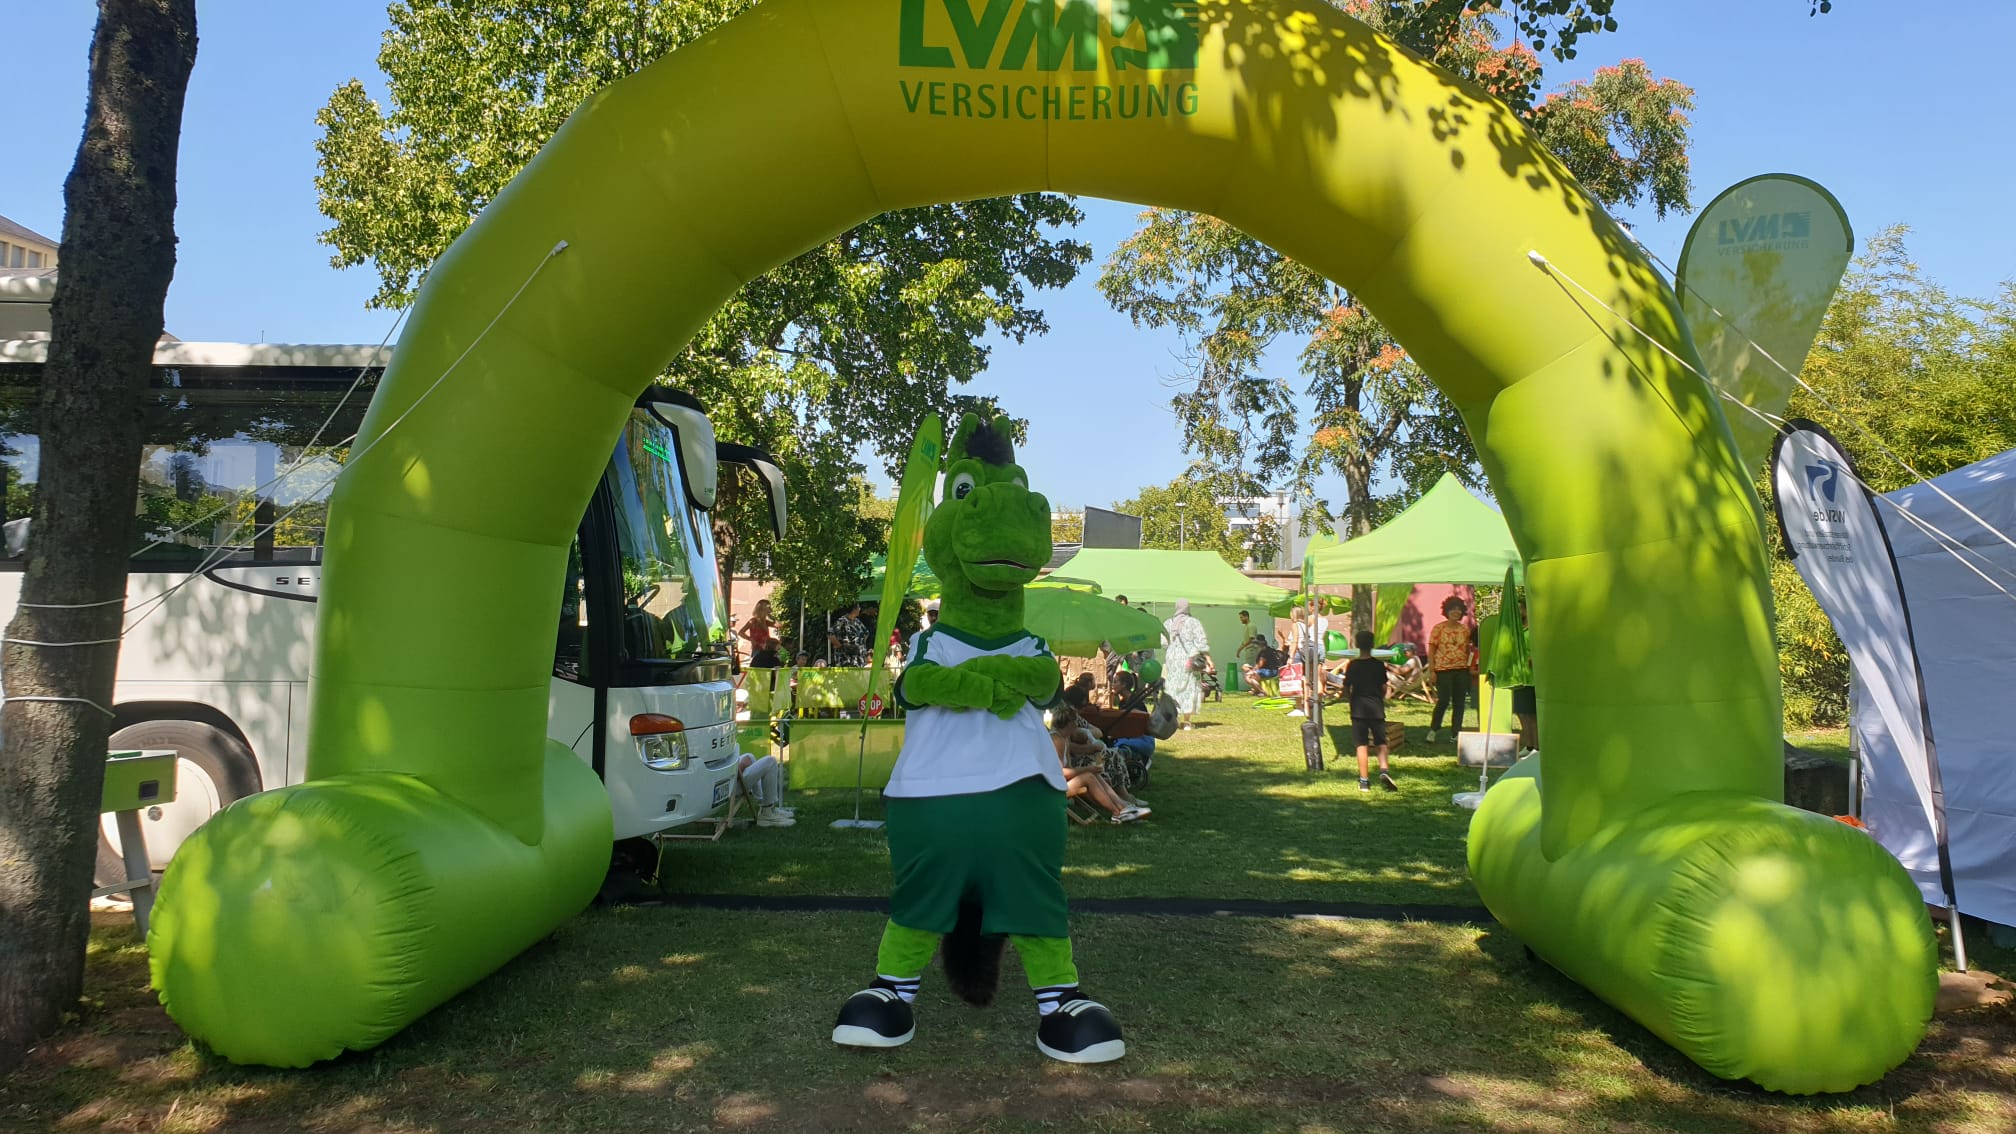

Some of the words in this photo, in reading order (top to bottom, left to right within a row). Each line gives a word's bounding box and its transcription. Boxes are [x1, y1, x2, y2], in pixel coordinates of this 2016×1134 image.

[898, 0, 1098, 72] LVM
[899, 80, 1199, 120] VERSICHERUNG
[1718, 213, 1780, 245] LVM
[860, 700, 882, 710] SOP
